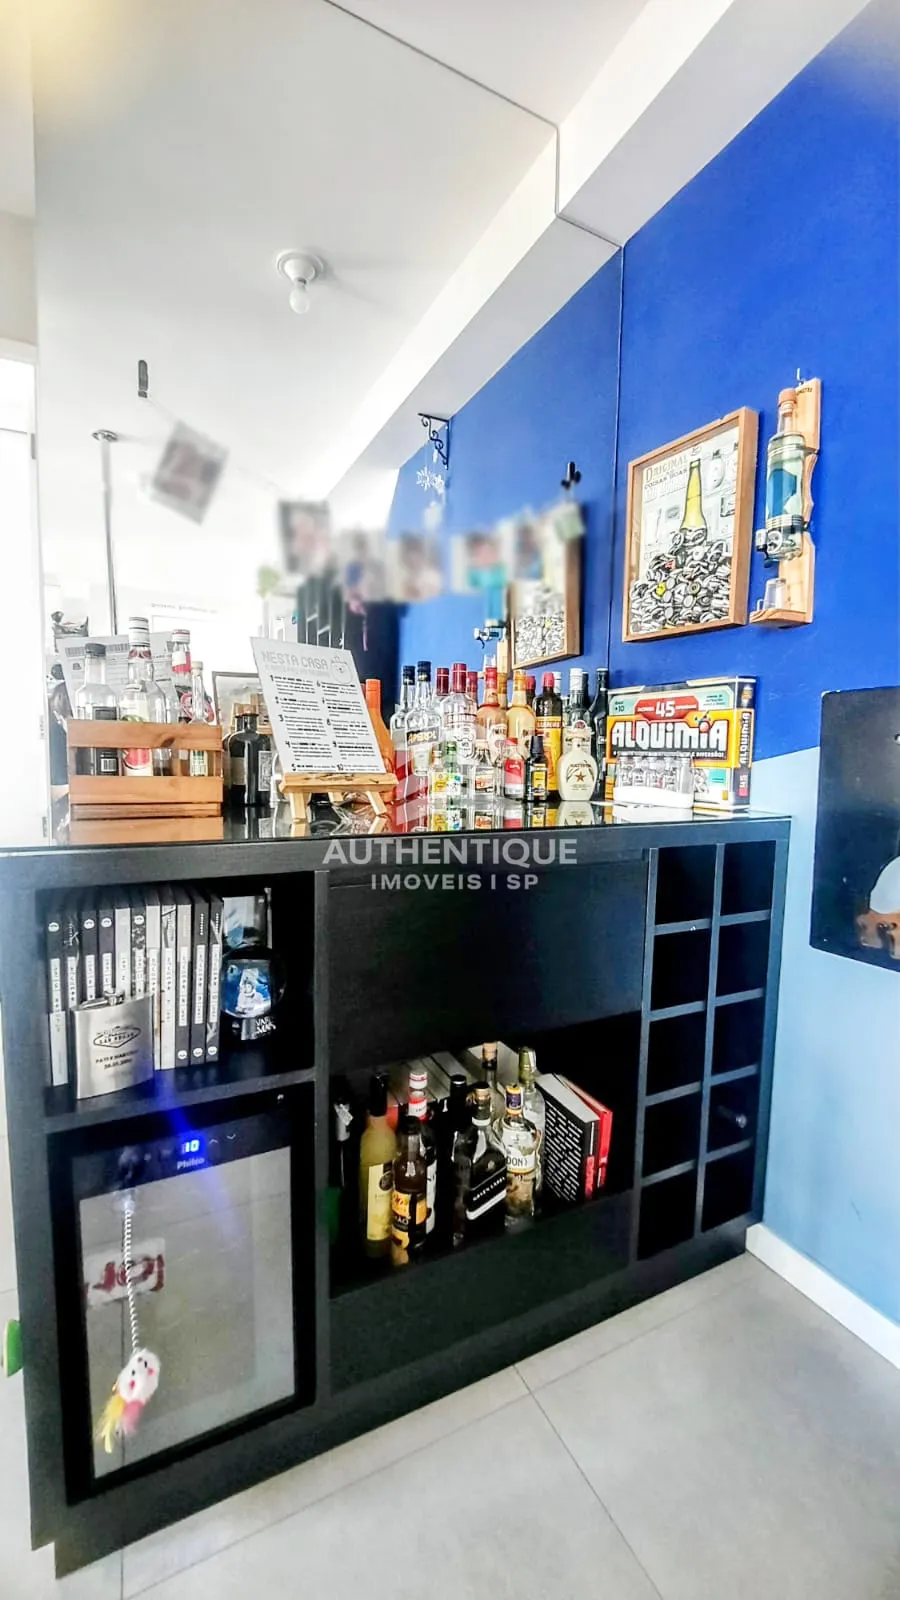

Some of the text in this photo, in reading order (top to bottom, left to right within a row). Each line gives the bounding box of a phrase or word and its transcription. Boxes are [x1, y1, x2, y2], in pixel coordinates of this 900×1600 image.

[261, 650, 329, 670] NESTA CASA
[655, 700, 675, 717] 45
[185, 1139, 200, 1153] 10
